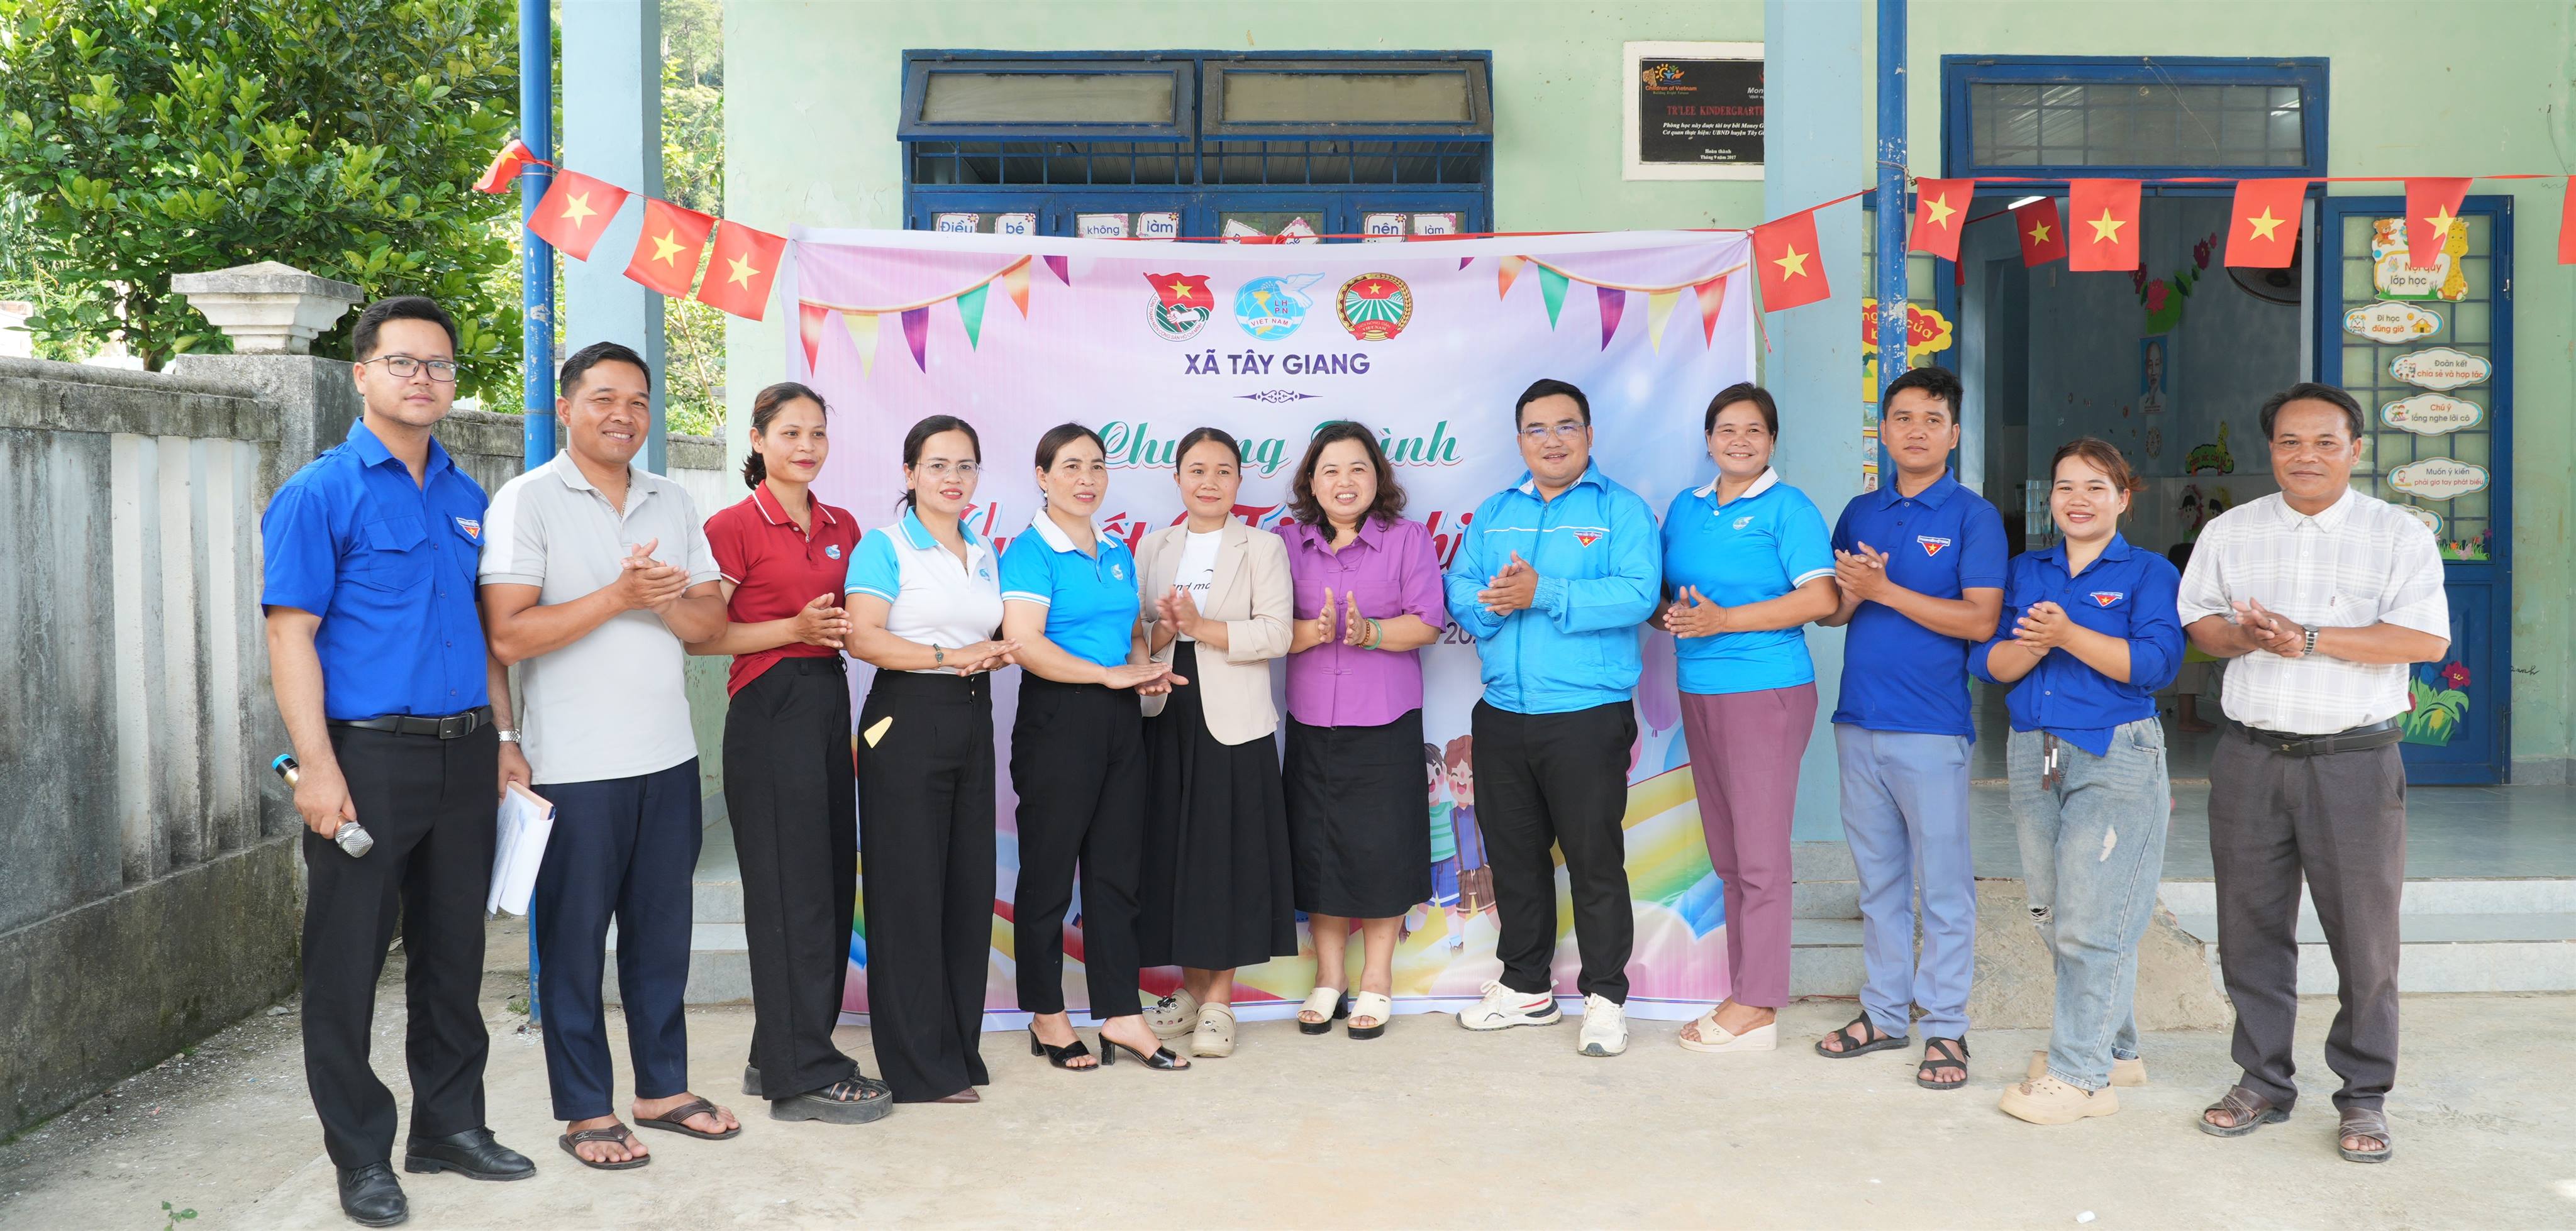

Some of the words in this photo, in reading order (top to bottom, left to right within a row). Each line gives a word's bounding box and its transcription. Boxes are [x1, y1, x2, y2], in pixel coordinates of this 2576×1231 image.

[1006, 221, 1024, 235] bé
[1087, 225, 1119, 236] không
[1372, 223, 1399, 235] nên
[1424, 224, 1444, 235] làm
[2390, 276, 2406, 286] lớp
[2408, 276, 2427, 287] học
[2386, 314, 2400, 323] học
[1907, 319, 1933, 339] của
[2372, 325, 2390, 334] đúng
[2392, 326, 2405, 334] giờ
[1185, 349, 1220, 375] XÃ
[1228, 349, 1275, 375] TÂY
[1282, 353, 1370, 375] GIANG
[2434, 359, 2454, 367] Đoàn
[2429, 415, 2448, 423] nghe
[2426, 467, 2446, 475] Muốn
